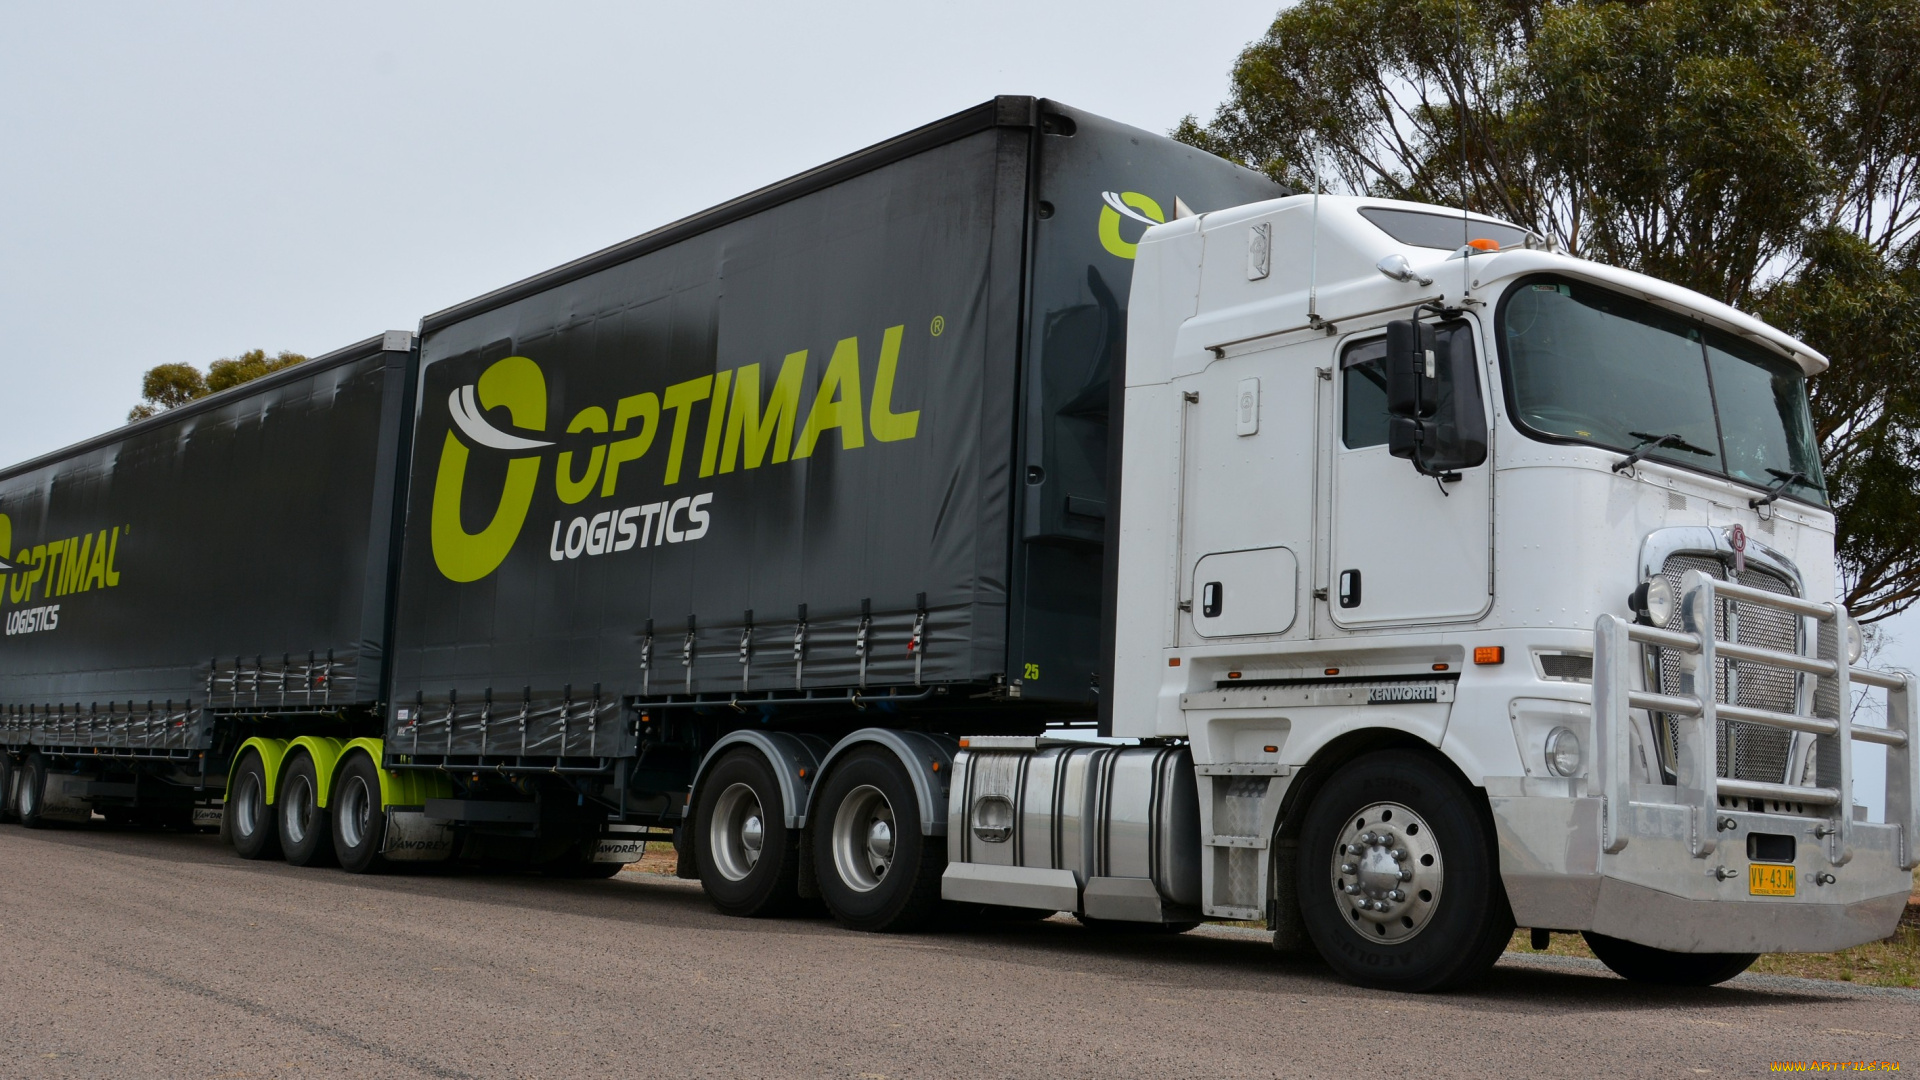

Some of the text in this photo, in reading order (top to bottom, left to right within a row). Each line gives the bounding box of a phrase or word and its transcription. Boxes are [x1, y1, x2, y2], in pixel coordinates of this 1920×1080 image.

[555, 324, 921, 505] OPTIMAL
[549, 491, 714, 562] LOGISTICS
[10, 526, 120, 604] OPTIMAL
[5, 604, 60, 636] LOGISTICS
[1024, 662, 1039, 680] 25
[1368, 686, 1437, 702] KENWORTH
[194, 809, 222, 820] VAWDR
[598, 844, 642, 854] AWDREY
